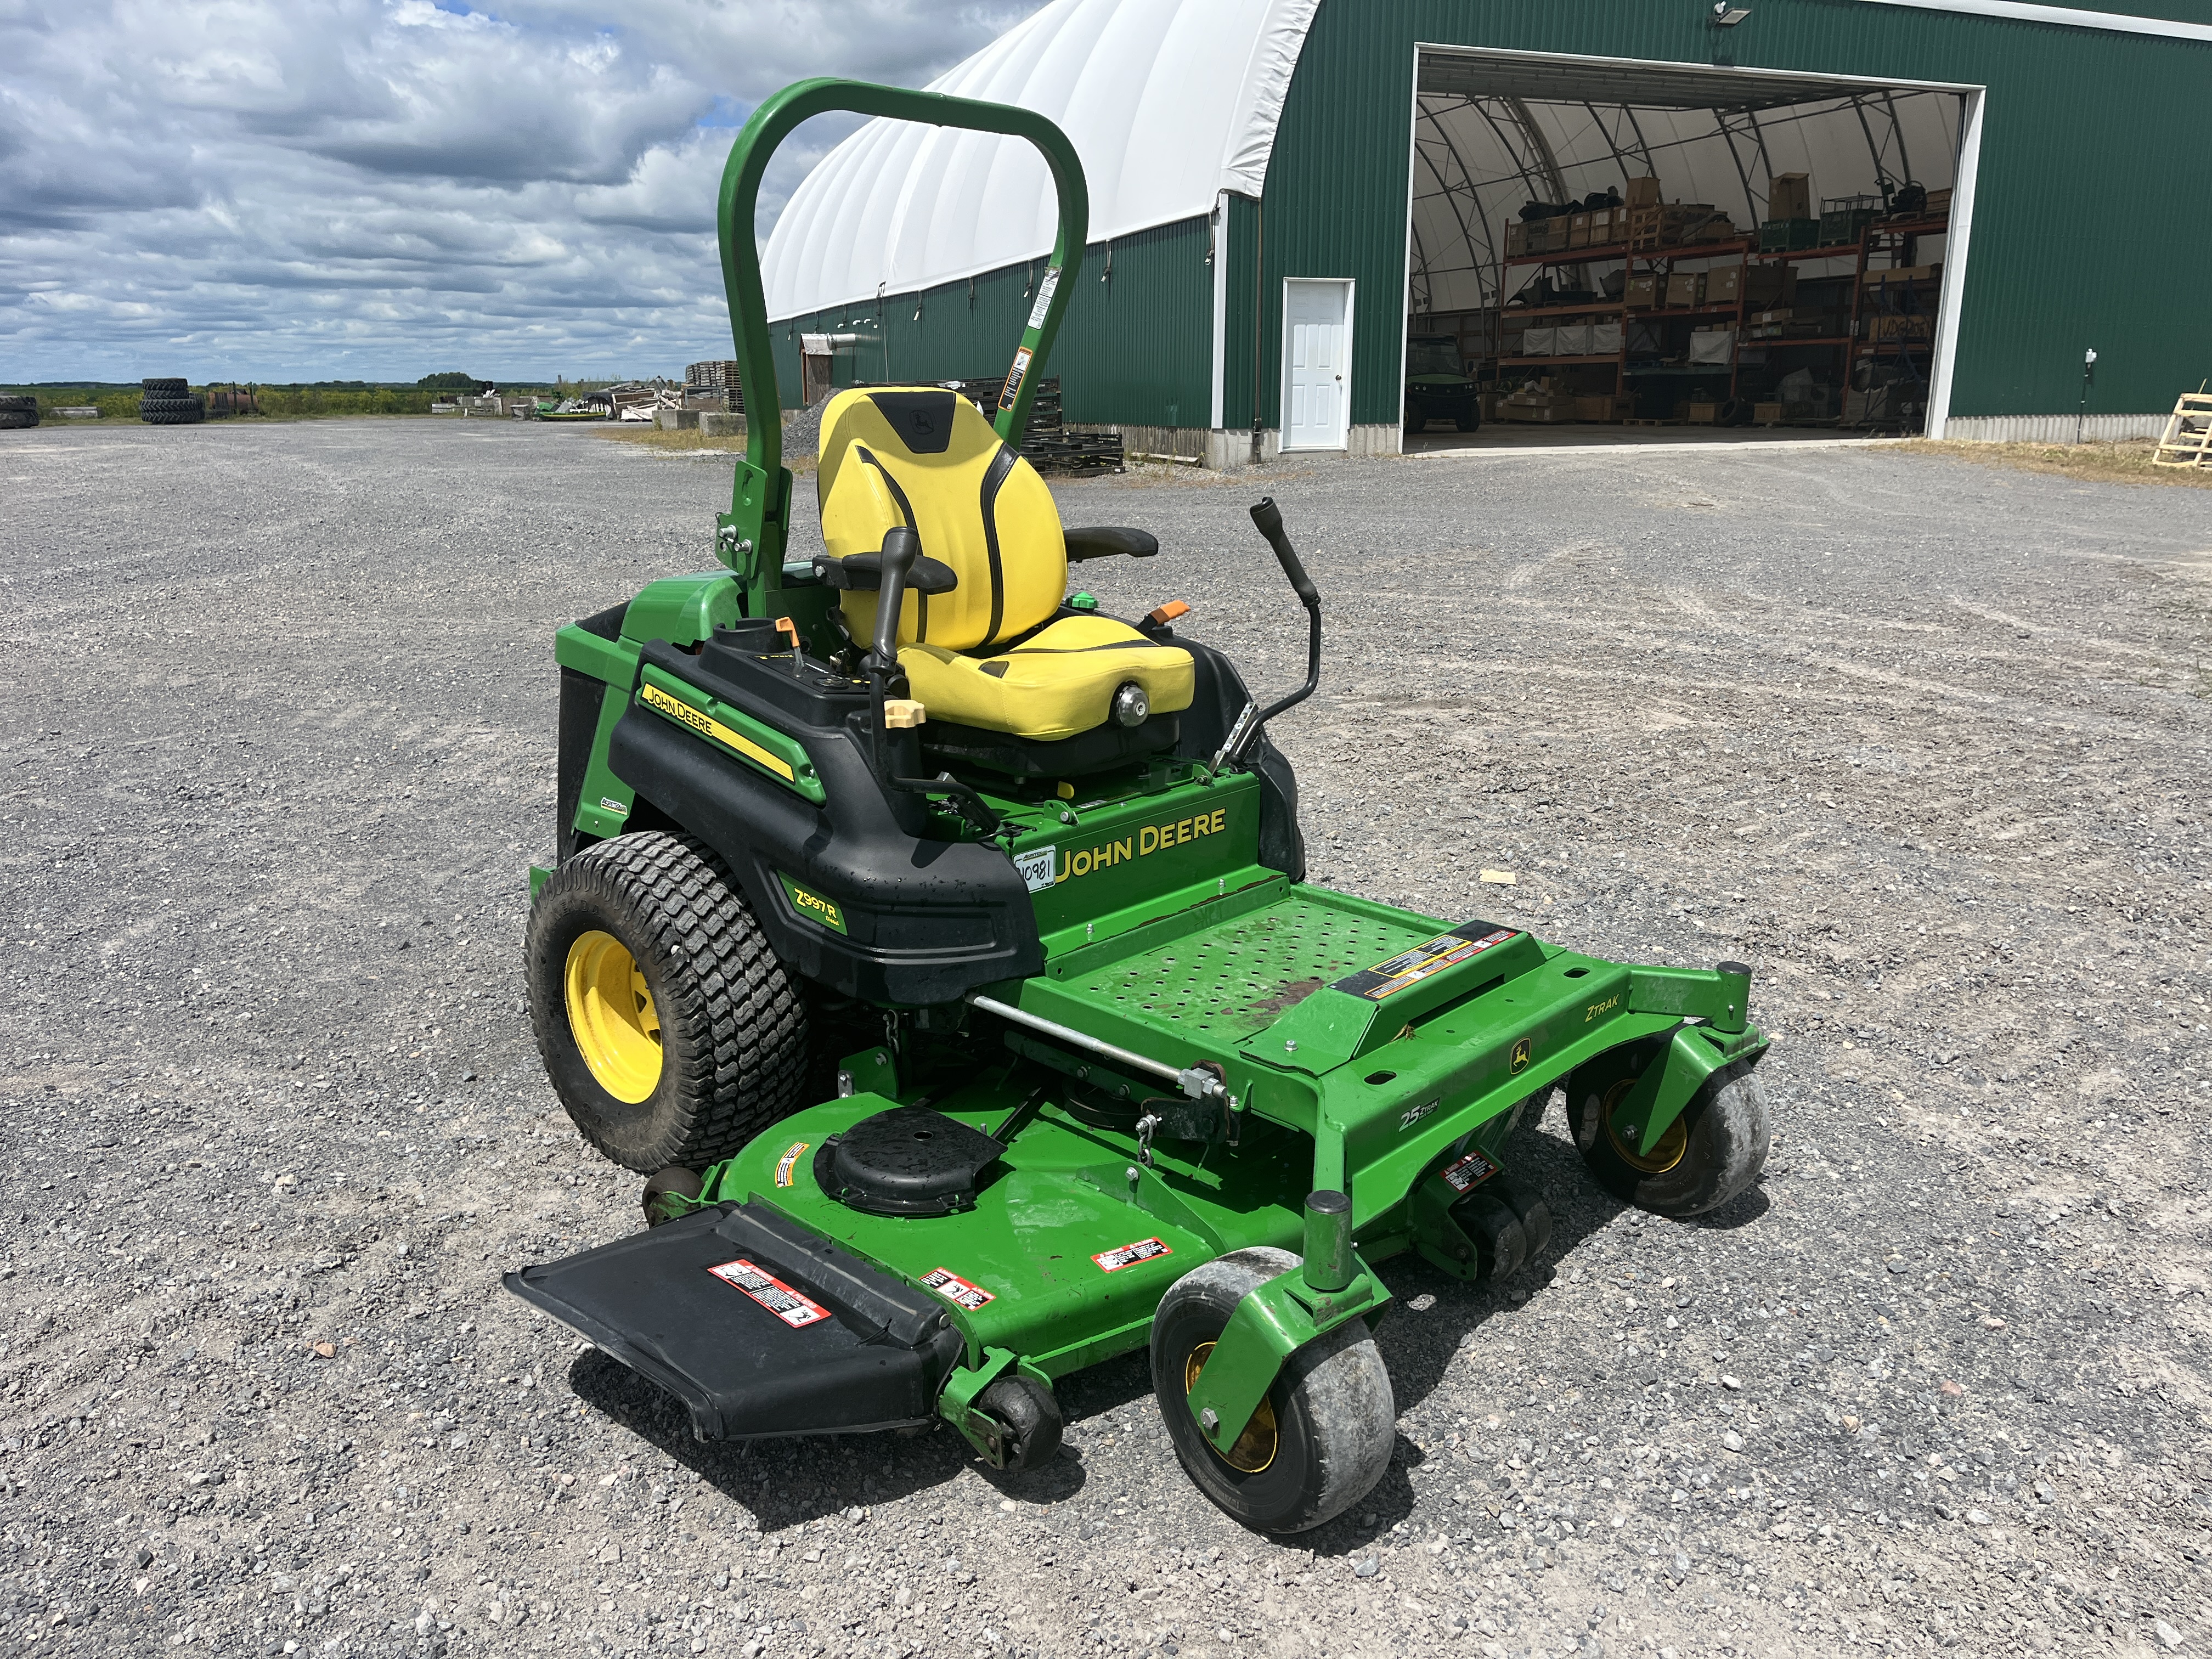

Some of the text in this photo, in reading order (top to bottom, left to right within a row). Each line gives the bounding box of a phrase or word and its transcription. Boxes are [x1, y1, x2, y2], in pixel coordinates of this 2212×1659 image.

[649, 689, 712, 735] JOHN DEERE
[1055, 807, 1226, 884] JOHN DEERE
[793, 887, 837, 919] Z997R
[825, 915, 840, 927] Diesel
[1584, 993, 1620, 1023] ZTRAK
[1398, 1104, 1420, 1132] 25
[1419, 1099, 1439, 1116] ZTRAK
[792, 1293, 817, 1309] PELIGRO
